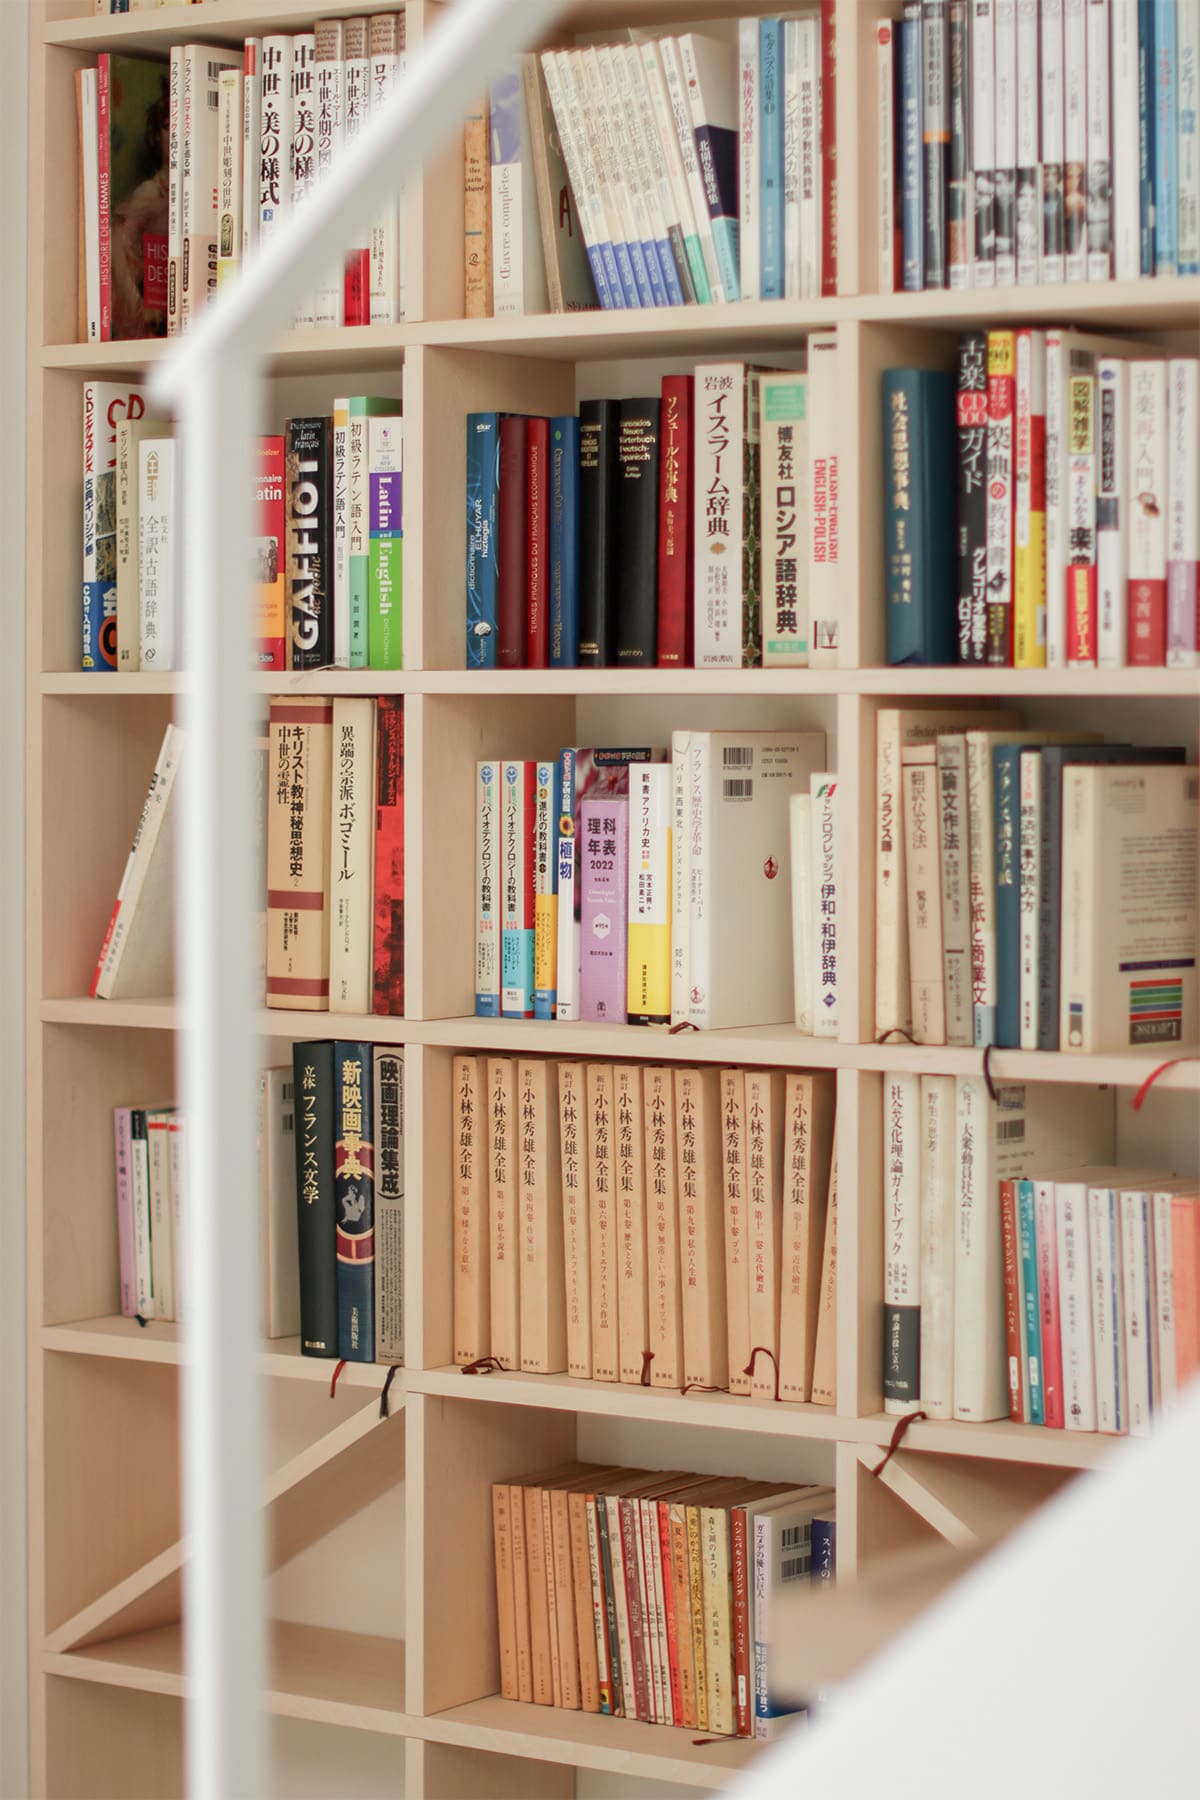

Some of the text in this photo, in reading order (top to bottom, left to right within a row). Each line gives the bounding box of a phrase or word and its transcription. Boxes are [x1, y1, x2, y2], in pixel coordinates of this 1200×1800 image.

[171, 61, 179, 97] フランス
[184, 59, 192, 93] フランス
[260, 46, 282, 206] 中世・美の様式
[223, 135, 233, 209] 中世彫刻の世界
[100, 171, 109, 286] HISTOIRE DES FEMMES
[106, 393, 146, 430] CD
[704, 375, 734, 391] 岩波
[1072, 381, 1091, 450] 図解雑学
[85, 388, 94, 474] CDエクスプレス
[294, 438, 321, 451] français
[300, 430, 316, 440] latin
[705, 393, 731, 537] イスラーム辞典
[777, 425, 793, 481] 博友社
[335, 431, 347, 539] 初級ラテン語入門
[350, 421, 363, 552] 初級ラテン語入門
[378, 476, 393, 529] Latin
[474, 499, 483, 551] ELHUYAR
[814, 459, 827, 563] ENGLISH-POLISH
[144, 514, 159, 640] 全訳古語辞典
[292, 460, 319, 651] GAFFIOT
[375, 541, 393, 616] English
[468, 534, 477, 590] dictionnaire
[481, 520, 490, 558] hiztegia
[530, 445, 539, 633] TERMES PRATIQUES DU FRANÇAIS ECONOMIQUE
[775, 486, 798, 634] ロシア語辞典
[289, 725, 305, 877] キリスト教神秘思想史
[538, 801, 548, 863] 進化の教科書
[587, 818, 616, 835] 理科
[641, 773, 650, 849] 新書アフリカ史
[691, 748, 703, 857] フランス歴史学革命
[880, 792, 893, 853] フランス語
[910, 770, 928, 849] 翻訳仏文法
[941, 772, 960, 851] 論文作法
[481, 803, 492, 912] バイオテクノロジーの教科書
[506, 803, 517, 912] バイオテクノロジーの教科書
[559, 841, 573, 880] 植物
[587, 839, 616, 857] 年表
[590, 860, 614, 870] 2022
[303, 1064, 319, 1205] 立体 フランス文学
[342, 1059, 362, 1181] 新映画事典
[459, 1083, 473, 1180] 小林秀雄全集
[493, 1086, 507, 1184] 小林秀雄全集
[522, 1088, 536, 1186] 小林秀雄全集
[562, 1090, 579, 1189] 小林秀雄全集
[594, 1093, 609, 1193] 小林秀雄全集
[618, 1092, 633, 1192] 小林秀雄全集
[651, 1095, 667, 1195] 小林秀雄全集
[680, 1098, 697, 1198] 小林秀雄全集
[725, 1098, 741, 1199] 小林秀雄全集
[750, 1102, 765, 1203] 小林秀雄全集
[791, 1103, 807, 1205] 小林秀雄全集
[890, 1084, 905, 1256] 社会文化理論ガイドブック
[708, 1516, 718, 1579] 森と湖のまつり
[734, 1521, 744, 1596] ハンニバル・ライジング
[756, 1523, 765, 1600] ガニメデの優しい巨人
[821, 1537, 832, 1578] スパイの
